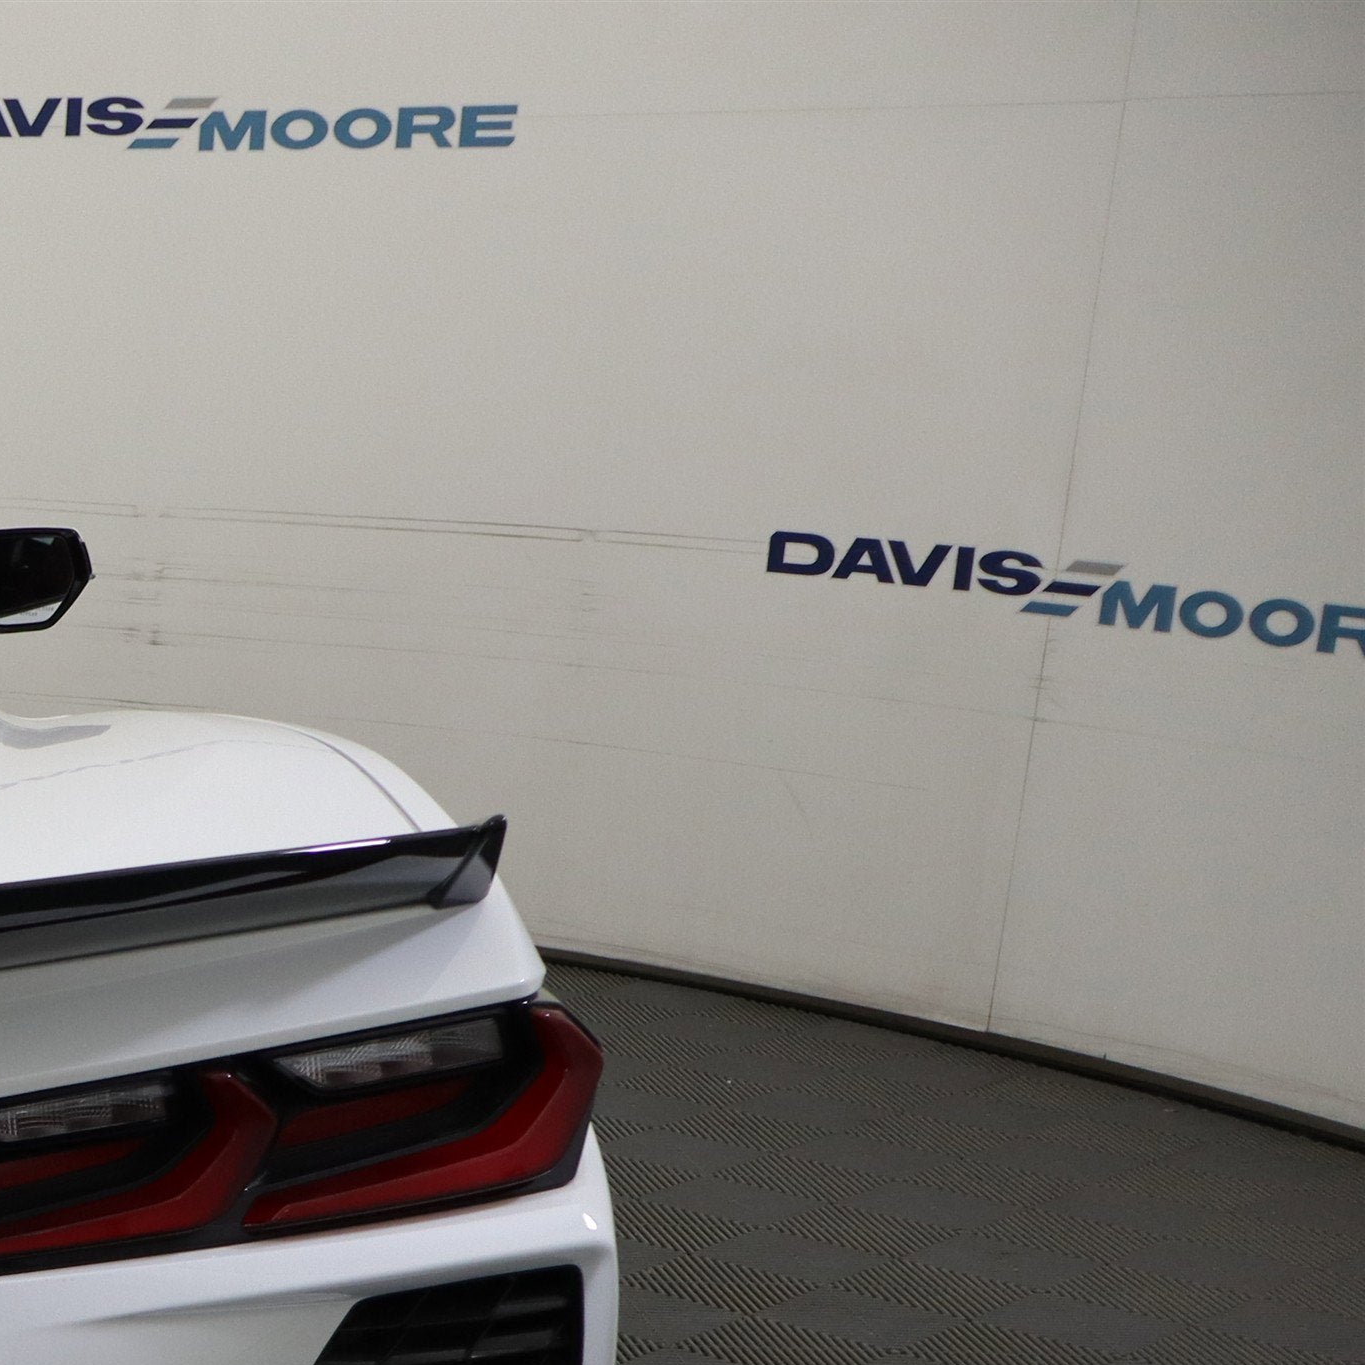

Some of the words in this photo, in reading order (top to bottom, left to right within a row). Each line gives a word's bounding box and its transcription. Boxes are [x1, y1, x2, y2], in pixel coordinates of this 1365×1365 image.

[198, 104, 519, 152] MOORE
[765, 530, 1043, 597] DAVIS
[1098, 580, 1365, 658] MOOR
